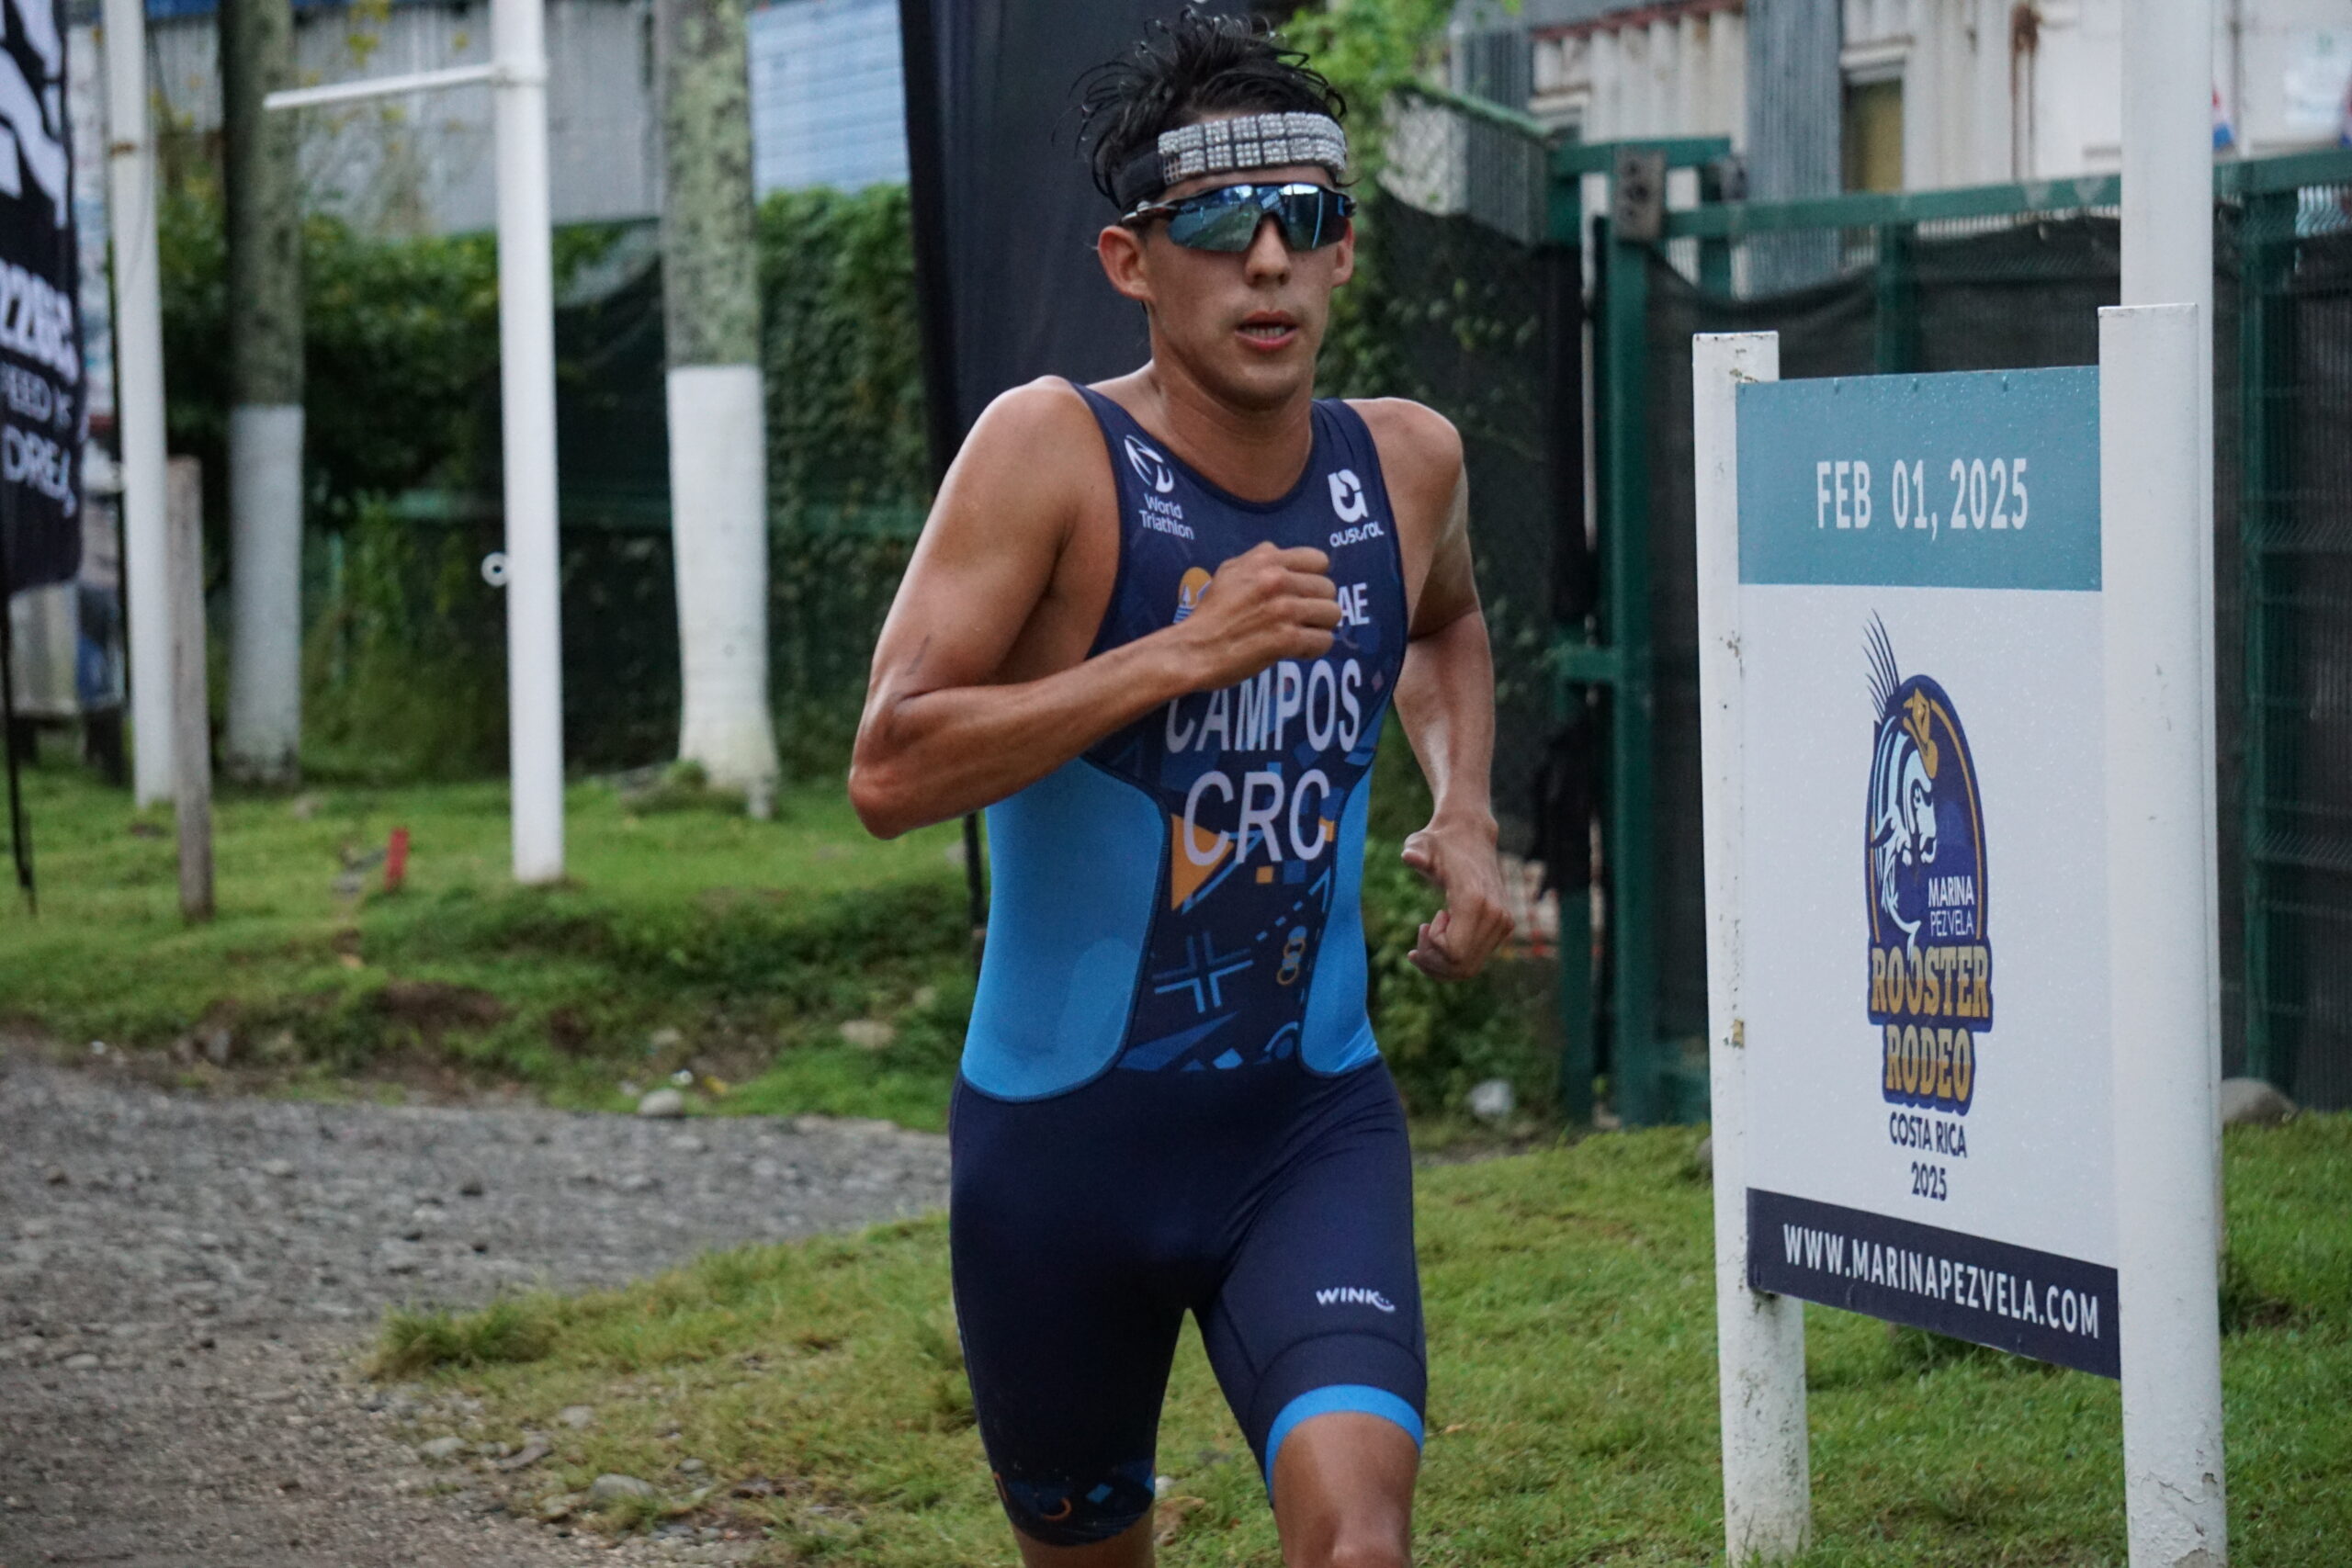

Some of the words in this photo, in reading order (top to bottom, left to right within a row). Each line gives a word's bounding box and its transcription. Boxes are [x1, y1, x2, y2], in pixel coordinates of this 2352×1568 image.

[1144, 493, 1183, 520] World
[1816, 461, 1872, 530] FEB
[1138, 509, 1194, 540] Triathlon
[1329, 521, 1385, 547] austral
[1165, 659, 1362, 754] CAMPOS
[1182, 769, 1331, 865] CRC
[1928, 875, 1975, 908] MARINA
[1871, 945, 1989, 1019] ROOSTER
[1886, 1024, 1972, 1102] RODEO
[1890, 1111, 1933, 1152] COSTA
[1936, 1120, 1967, 1158] RICA
[1911, 1161, 1947, 1201] 2025
[1316, 1287, 1396, 1313] WINK
[1782, 1223, 2099, 1339] WWW.MARINAPEZVELA.COM
